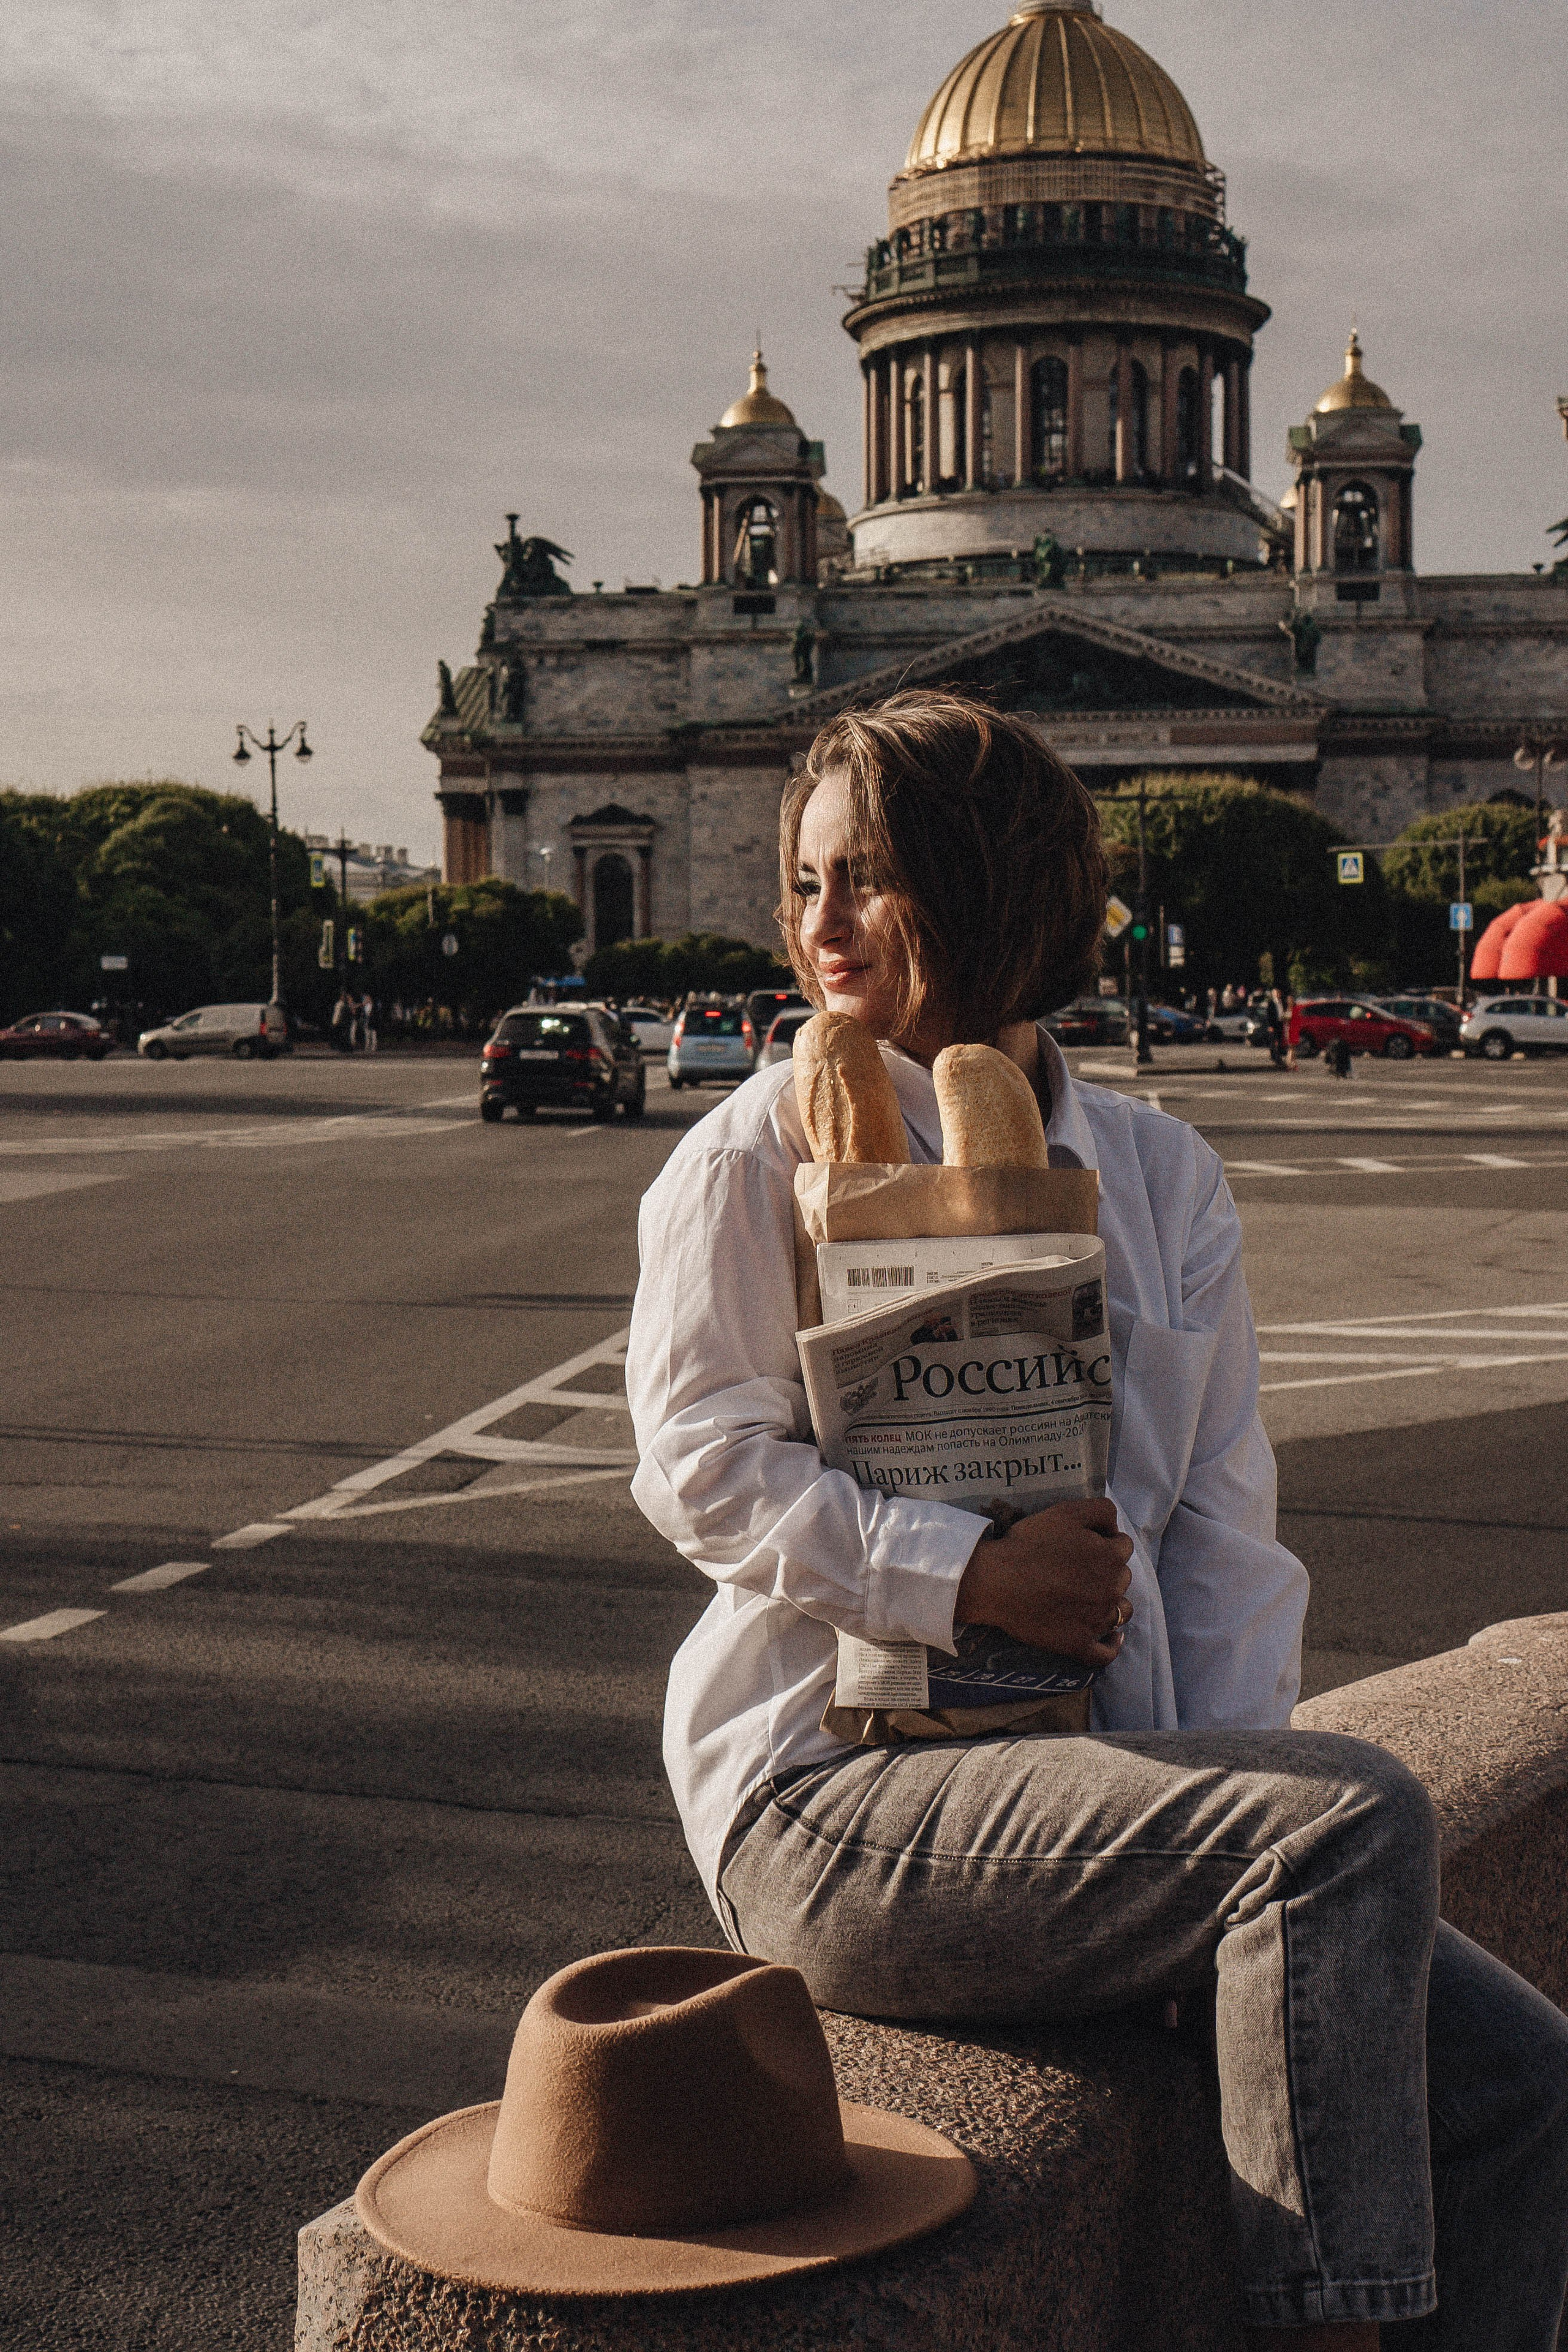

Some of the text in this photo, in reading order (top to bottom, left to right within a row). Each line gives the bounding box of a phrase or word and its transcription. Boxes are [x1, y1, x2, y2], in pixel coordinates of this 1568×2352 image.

[845, 1434, 869, 1444] ПЯТЬ
[871, 1433, 902, 1443] КОЛЕЦ
[905, 1430, 932, 1442] МОК
[935, 1430, 948, 1439] не
[949, 1426, 1006, 1439] допускает
[1009, 1420, 1057, 1436] россиян
[1059, 1417, 1071, 1427] на
[846, 1446, 880, 1455] нашим
[883, 1443, 935, 1455] надеждам
[937, 1438, 980, 1452] попасть
[983, 1438, 996, 1447] на
[850, 1453, 1082, 1493] Париж закрыт...
[1055, 1678, 1080, 1687] 26
